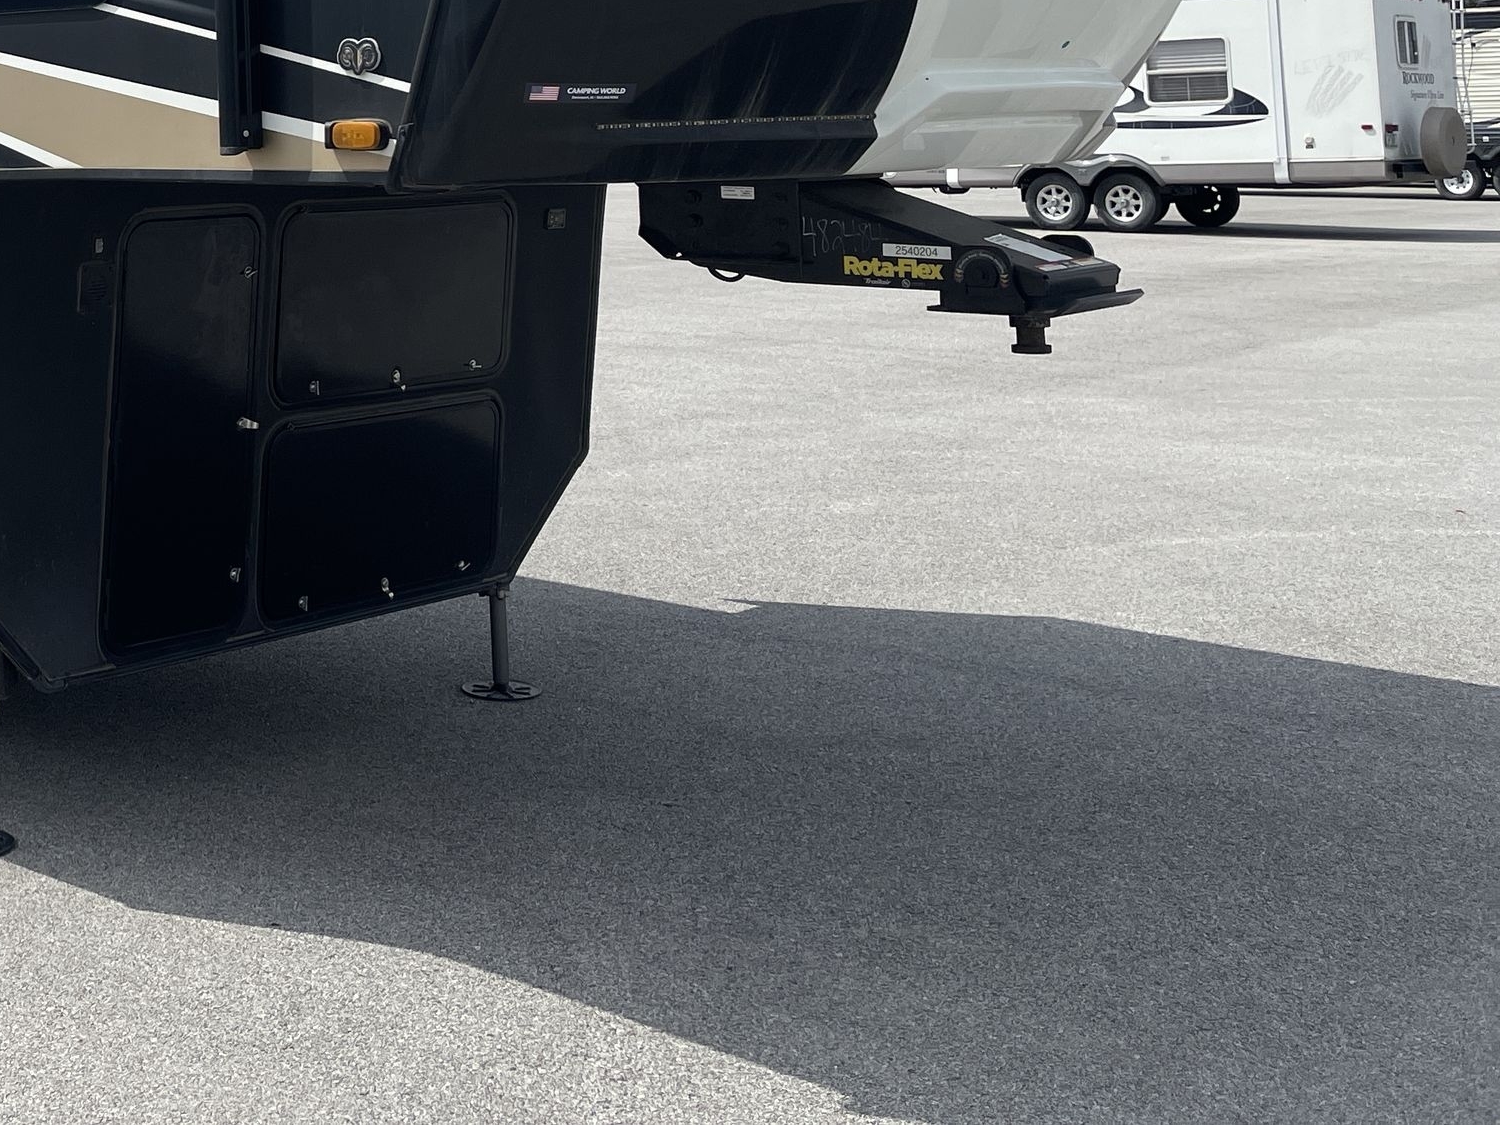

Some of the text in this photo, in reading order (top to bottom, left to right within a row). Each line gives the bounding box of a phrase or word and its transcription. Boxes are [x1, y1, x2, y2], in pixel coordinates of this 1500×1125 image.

[1402, 71, 1435, 85] ROCKWOOD
[567, 87, 627, 95] CAMPING WORLD
[895, 245, 938, 257] 2540204
